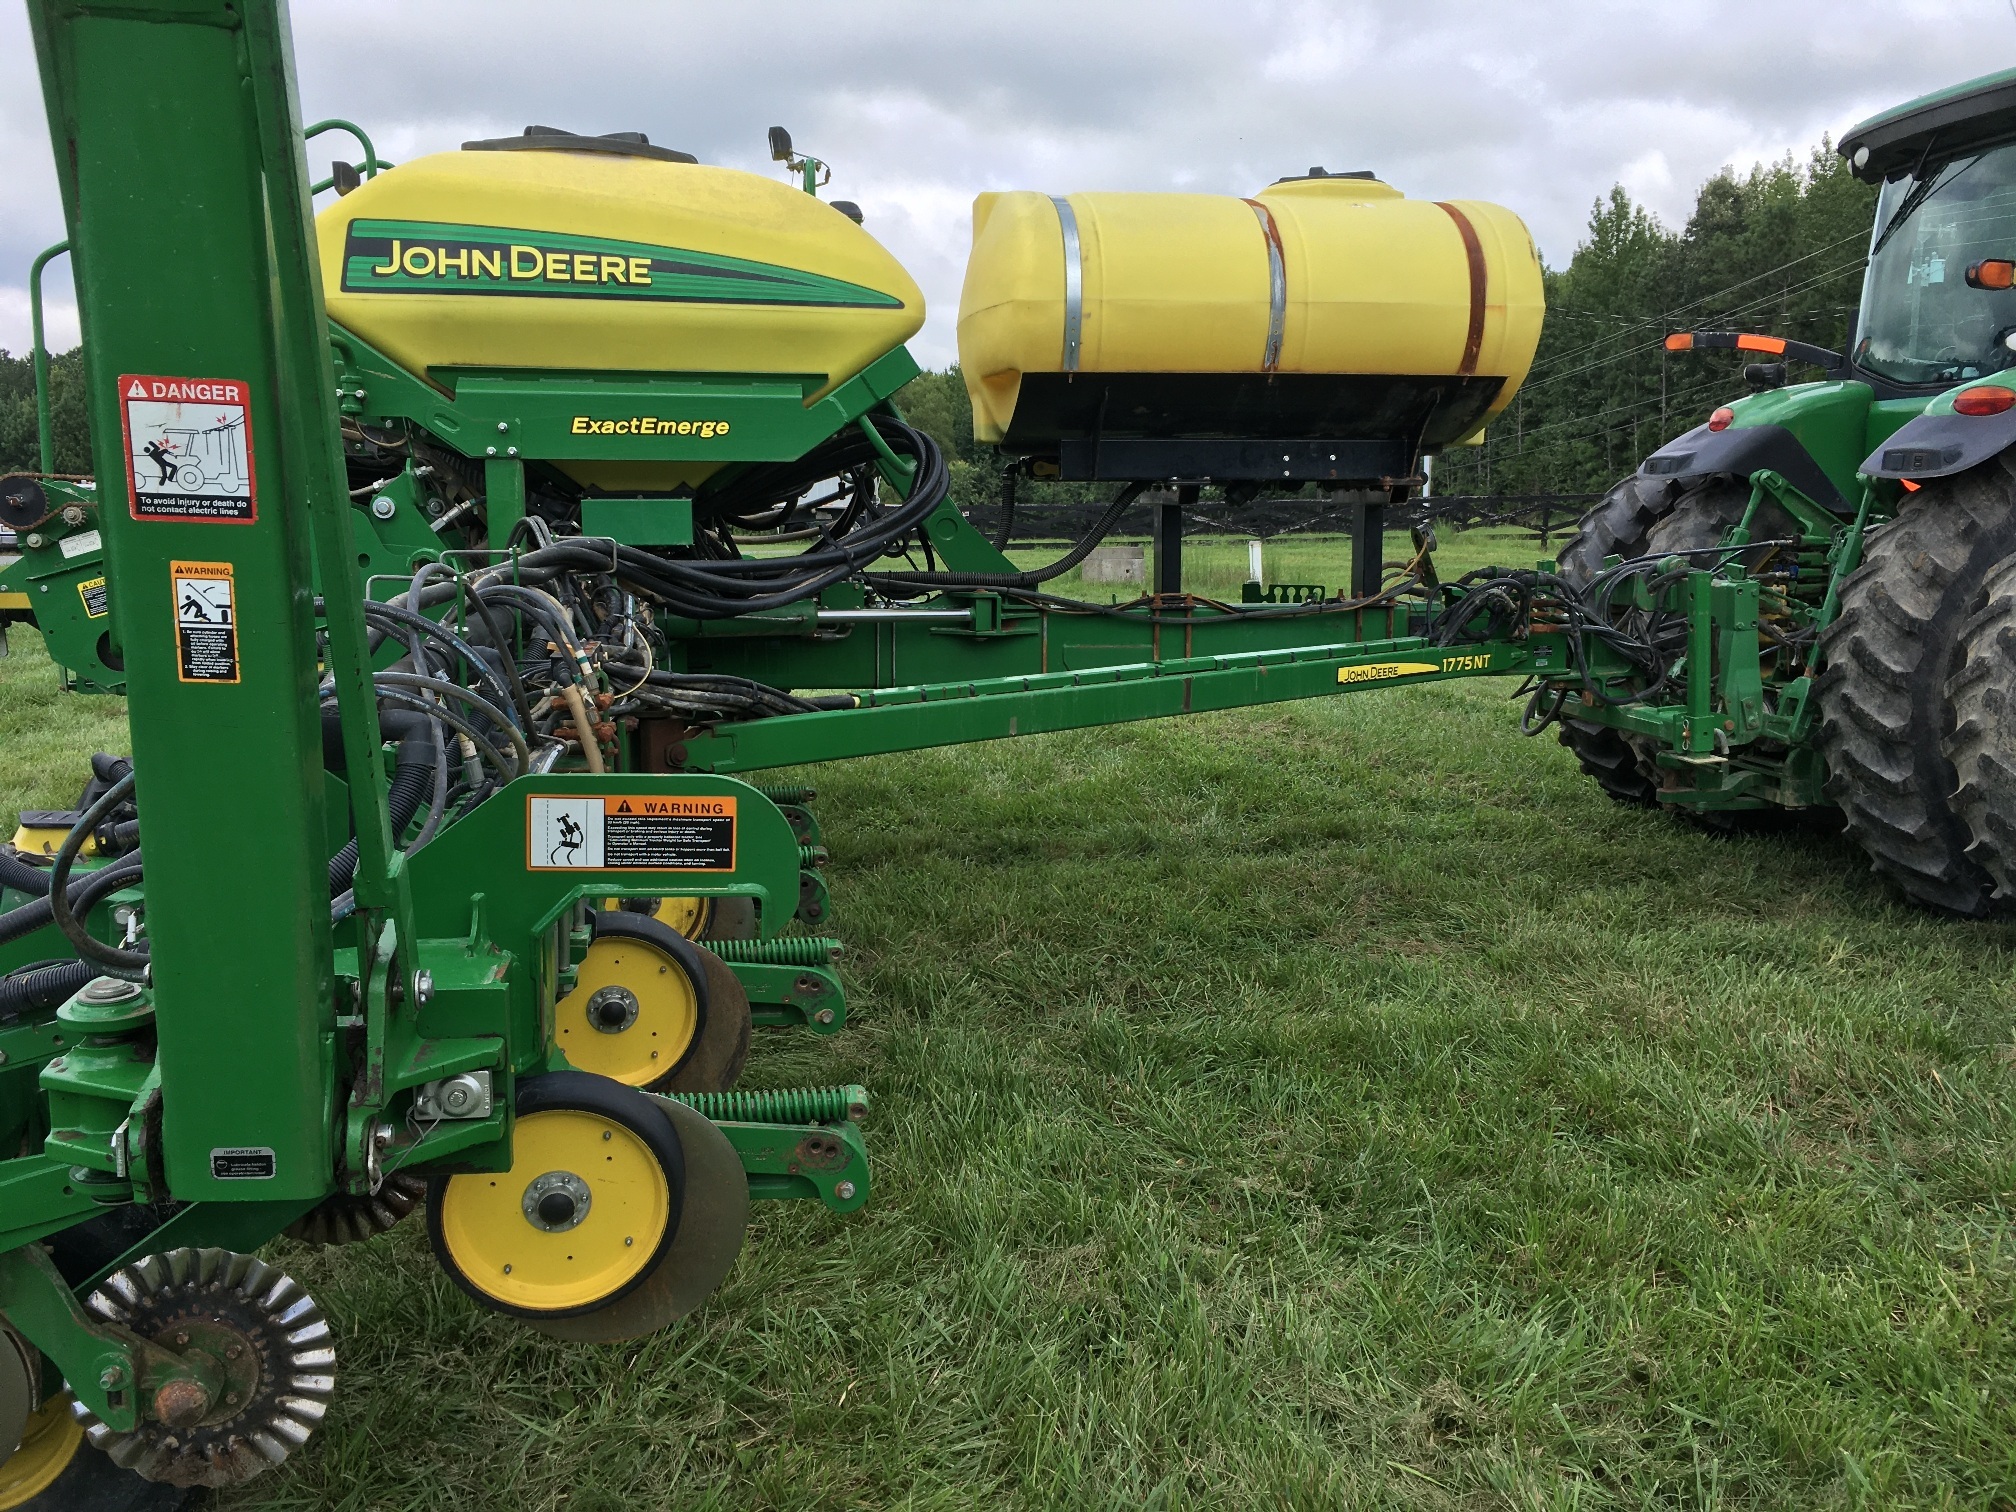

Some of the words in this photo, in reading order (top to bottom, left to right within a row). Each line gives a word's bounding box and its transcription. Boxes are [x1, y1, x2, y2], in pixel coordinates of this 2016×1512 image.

[373, 239, 502, 278] JOHN
[509, 245, 653, 285] DEERE
[152, 382, 240, 401] DANGER
[571, 416, 730, 439] ExactEmerge
[177, 498, 200, 507] injury
[212, 499, 234, 507] death
[188, 506, 218, 514] electric
[184, 567, 230, 576] WARNING
[1344, 667, 1368, 681] JOHN
[1370, 666, 1398, 678] DEERE
[1442, 654, 1490, 672] 1775NT
[644, 803, 724, 814] WARNING
